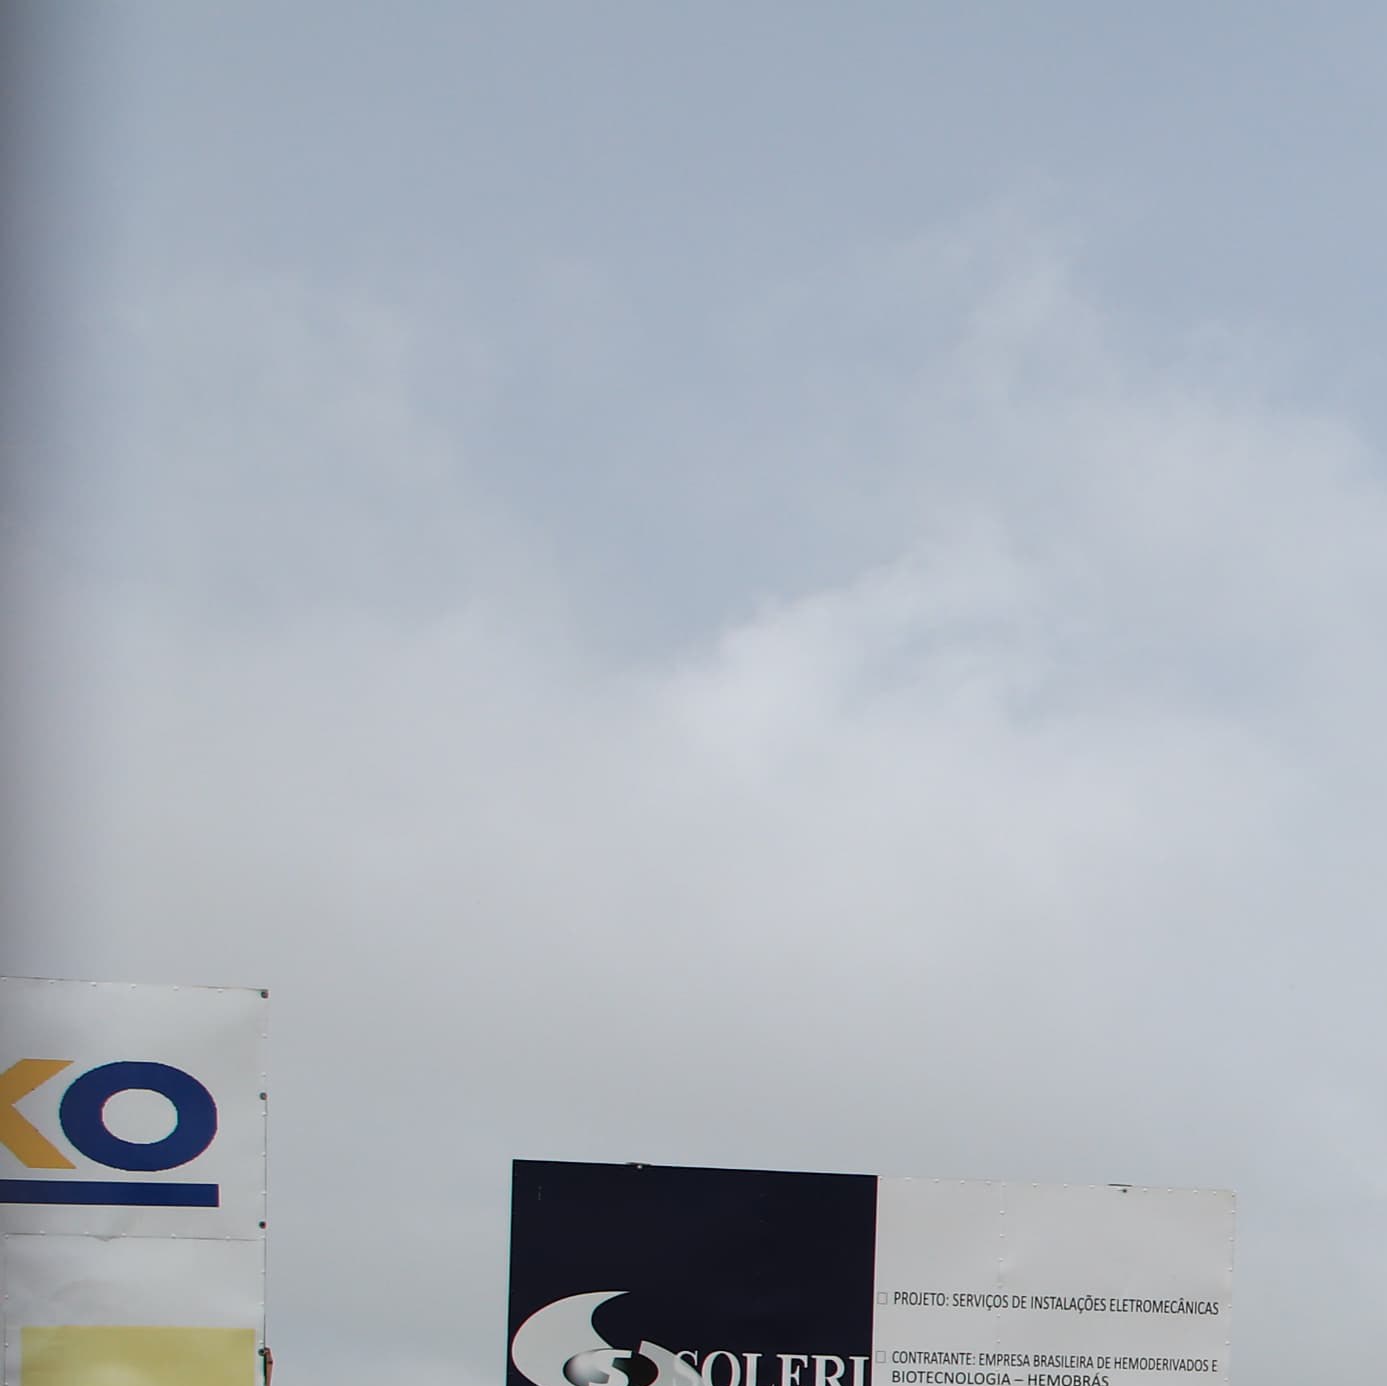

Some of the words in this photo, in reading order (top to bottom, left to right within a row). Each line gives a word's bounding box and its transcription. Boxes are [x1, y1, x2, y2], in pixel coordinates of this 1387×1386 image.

[894, 1291, 949, 1308] PROJETO:
[953, 1294, 1008, 1310] SERVIÇOS
[1012, 1296, 1026, 1309] DE
[1031, 1295, 1106, 1313] INSTALAÇÕES
[1110, 1298, 1218, 1315] ELETROMECÂNICAS
[892, 1351, 976, 1366] CONTRATANTE:
[979, 1353, 1030, 1366] EMPRESA
[1034, 1355, 1093, 1368] BRASILEIRA
[1097, 1357, 1110, 1369] DE
[1115, 1357, 1208, 1371] HEMODERIVADOS
[1212, 1360, 1217, 1372] E
[892, 1371, 1010, 1385] BIOTECNOLOGIA
